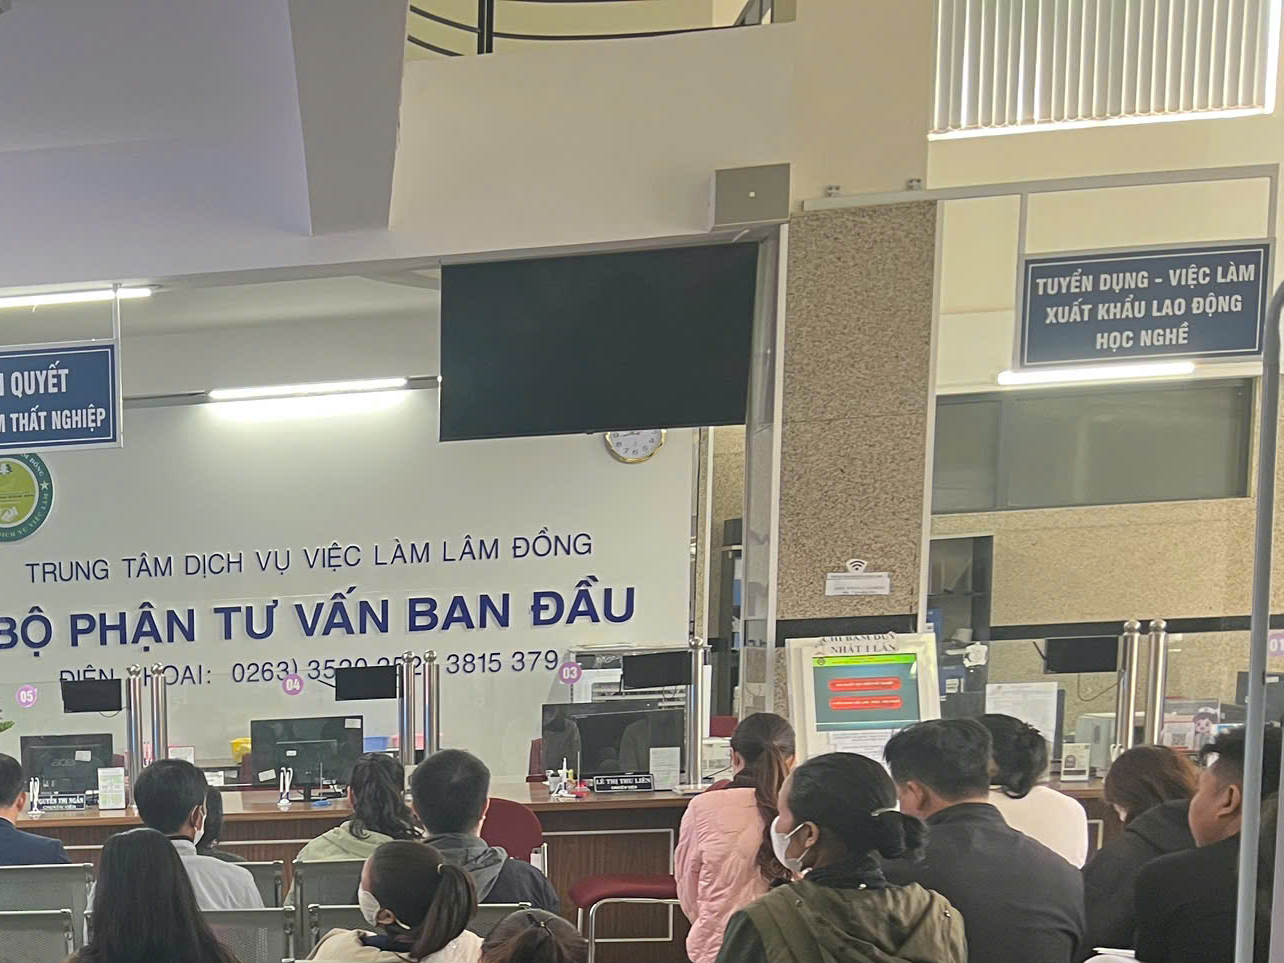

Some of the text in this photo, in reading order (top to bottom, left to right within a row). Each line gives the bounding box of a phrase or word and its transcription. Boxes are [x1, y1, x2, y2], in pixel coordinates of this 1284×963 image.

[1036, 268, 1093, 296] TUYỂN
[1099, 271, 1149, 293] DỤNG
[1169, 264, 1210, 289] VIỆC
[1217, 261, 1255, 283] LÀM
[1045, 292, 1243, 324] XUẤT KHẨU LAO ĐỘNG
[1095, 321, 1189, 352] HỌC NGHỀ
[11, 360, 69, 398] QUYẾT
[10, 405, 47, 432] THẤT
[51, 403, 106, 432] NGHIỆP
[25, 526, 593, 583] TRUNG TÂM DỊCH VỤ VIỆC LÀM LÂM ĐỒNG
[69, 601, 196, 652] PHẬN
[213, 599, 279, 641] TƯ
[294, 585, 389, 638] VẤN
[408, 593, 510, 633] BAN
[530, 574, 636, 627] ĐẦU
[446, 652, 503, 675] 3815
[511, 649, 558, 672] 379
[563, 666, 577, 679] 03
[20, 690, 33, 703] 05
[286, 678, 300, 690] 04
